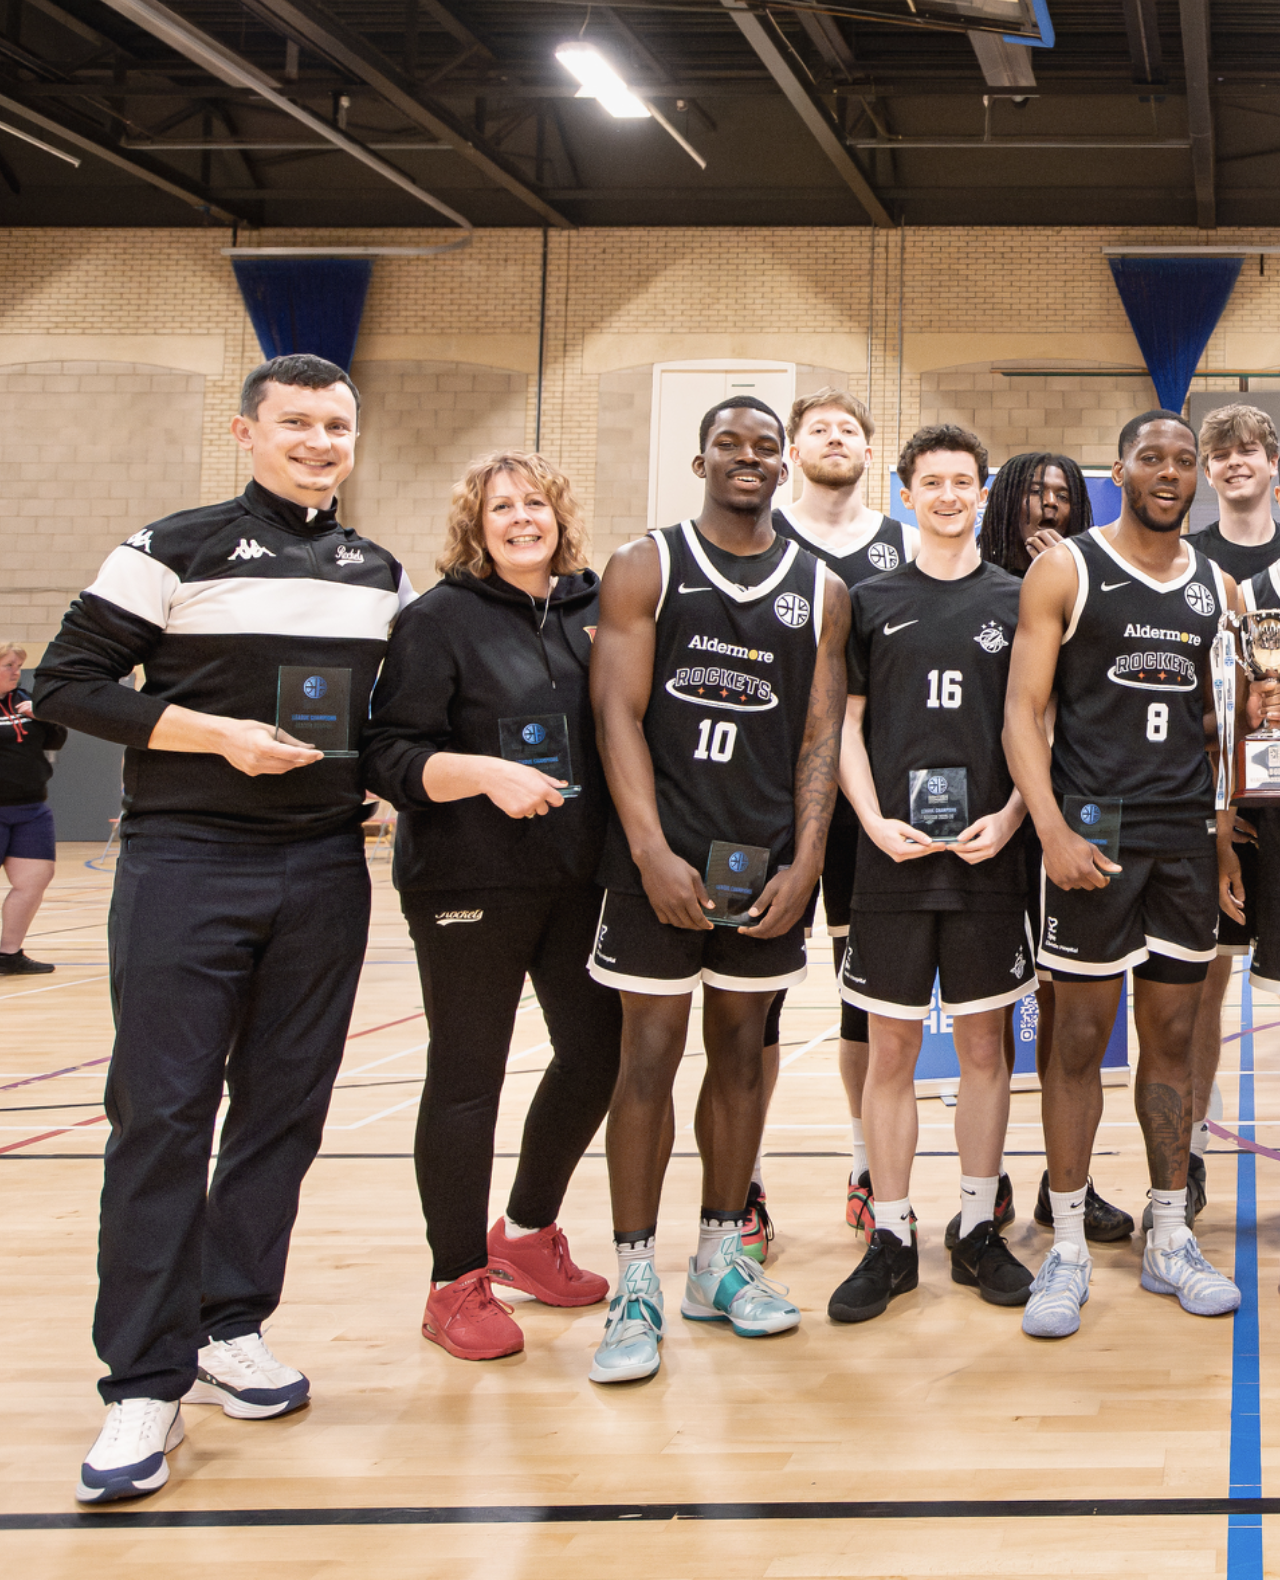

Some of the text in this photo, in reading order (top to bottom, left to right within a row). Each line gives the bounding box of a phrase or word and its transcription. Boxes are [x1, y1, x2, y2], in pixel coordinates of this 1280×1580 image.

[688, 635, 774, 663] Aldermore
[1123, 623, 1201, 646] Aldermore
[675, 666, 772, 700] ROCKETS
[1115, 651, 1196, 681] ROCKETS
[926, 669, 963, 708] 16
[1146, 702, 1169, 742] 8
[693, 718, 737, 763] 10
